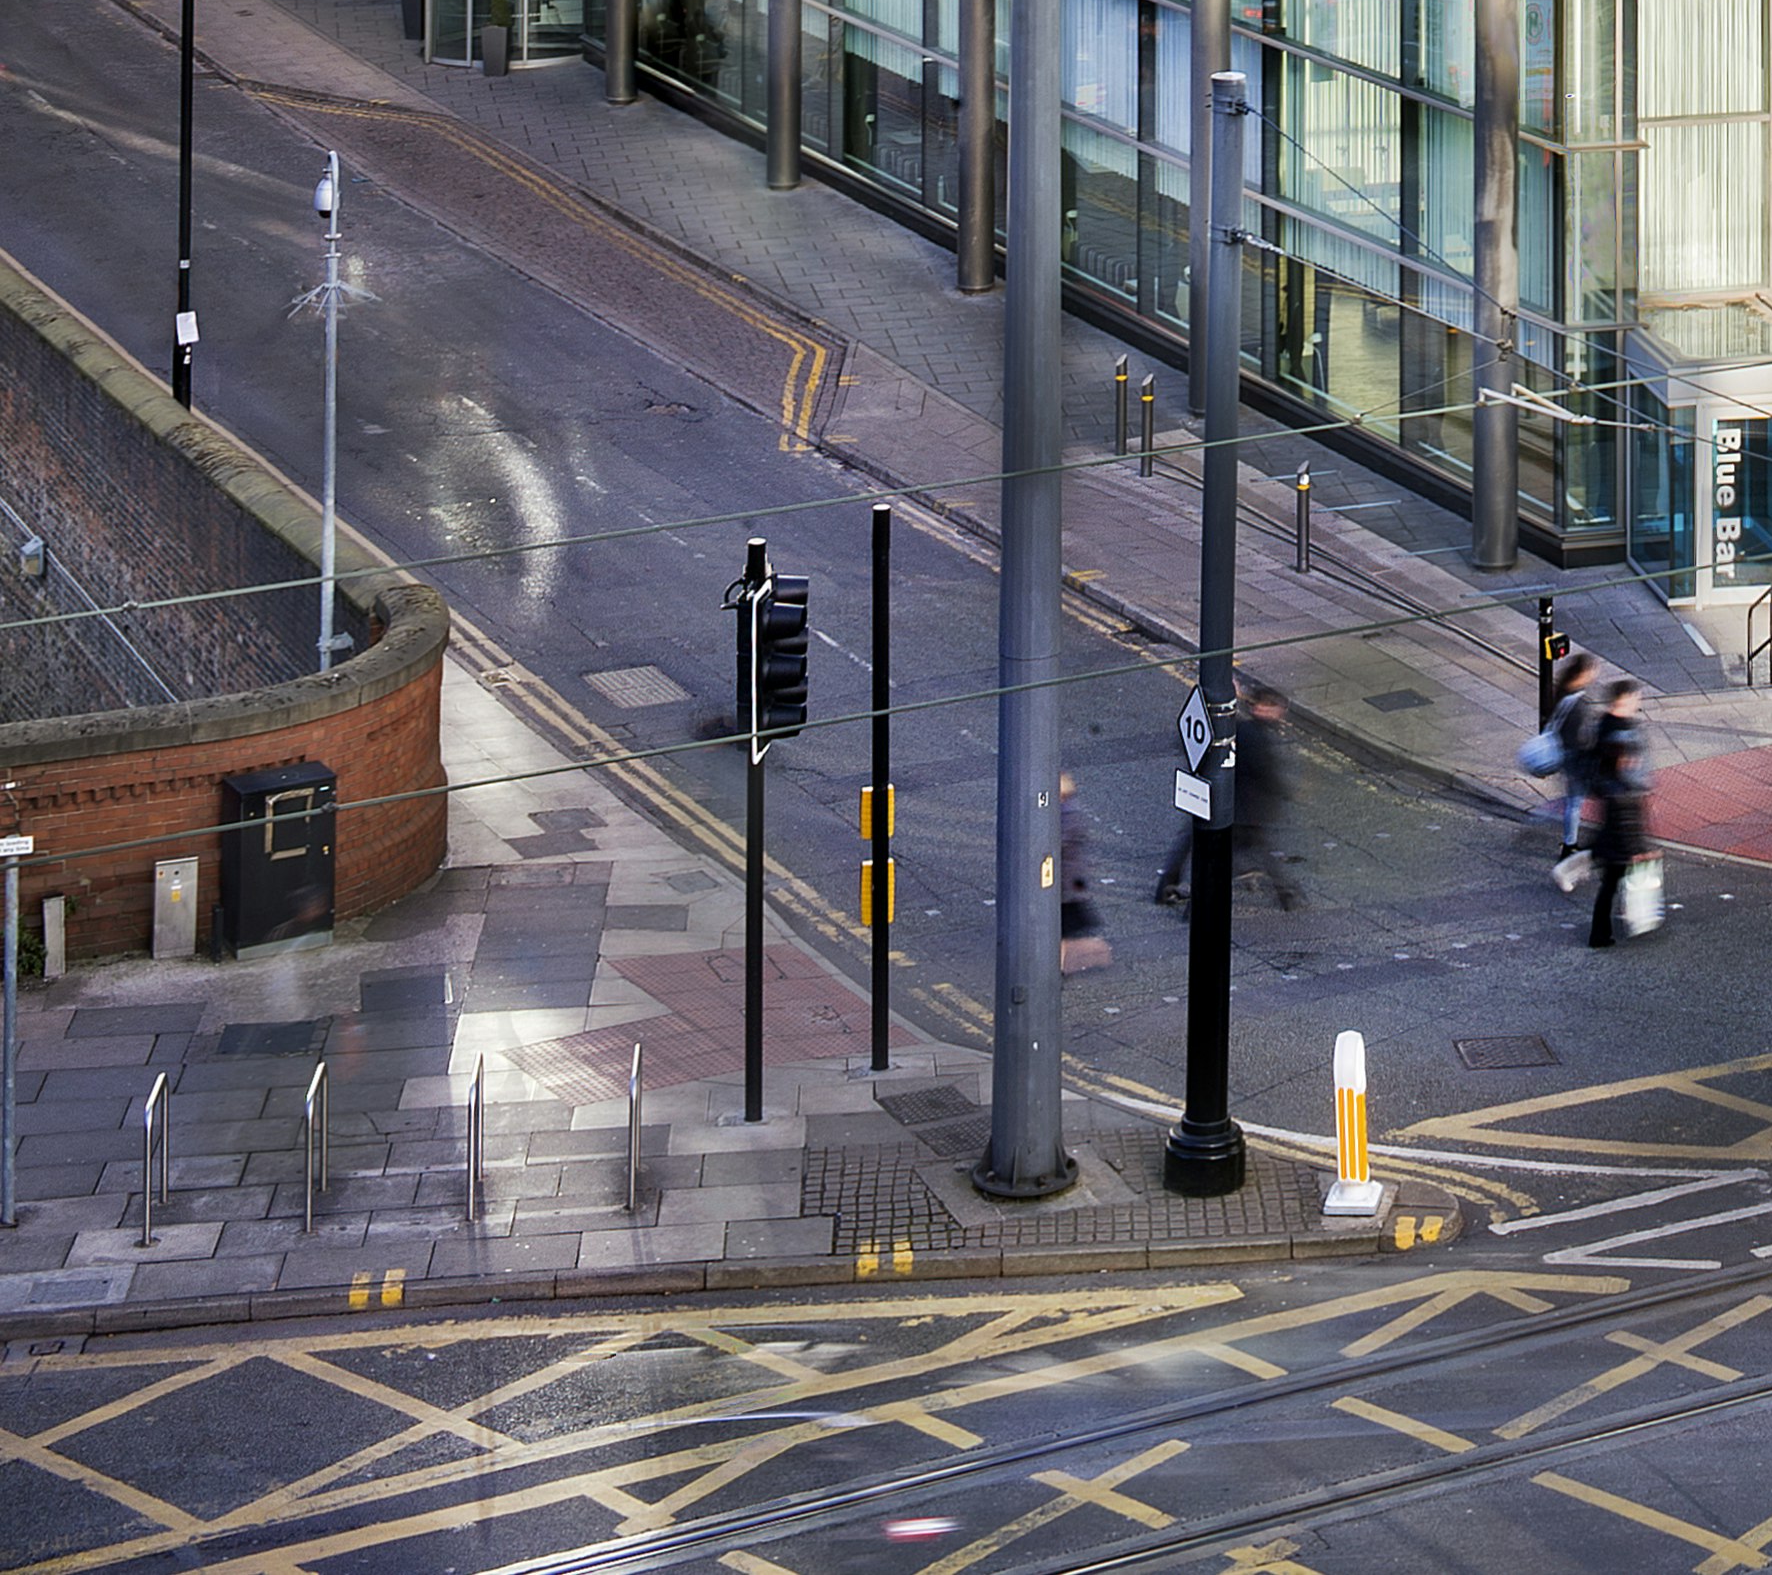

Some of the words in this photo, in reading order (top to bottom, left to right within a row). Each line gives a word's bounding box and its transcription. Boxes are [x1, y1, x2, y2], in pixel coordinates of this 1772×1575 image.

[1716, 428, 1741, 506] Blue
[1716, 518, 1741, 579] Bar
[1186, 715, 1205, 744] 10
